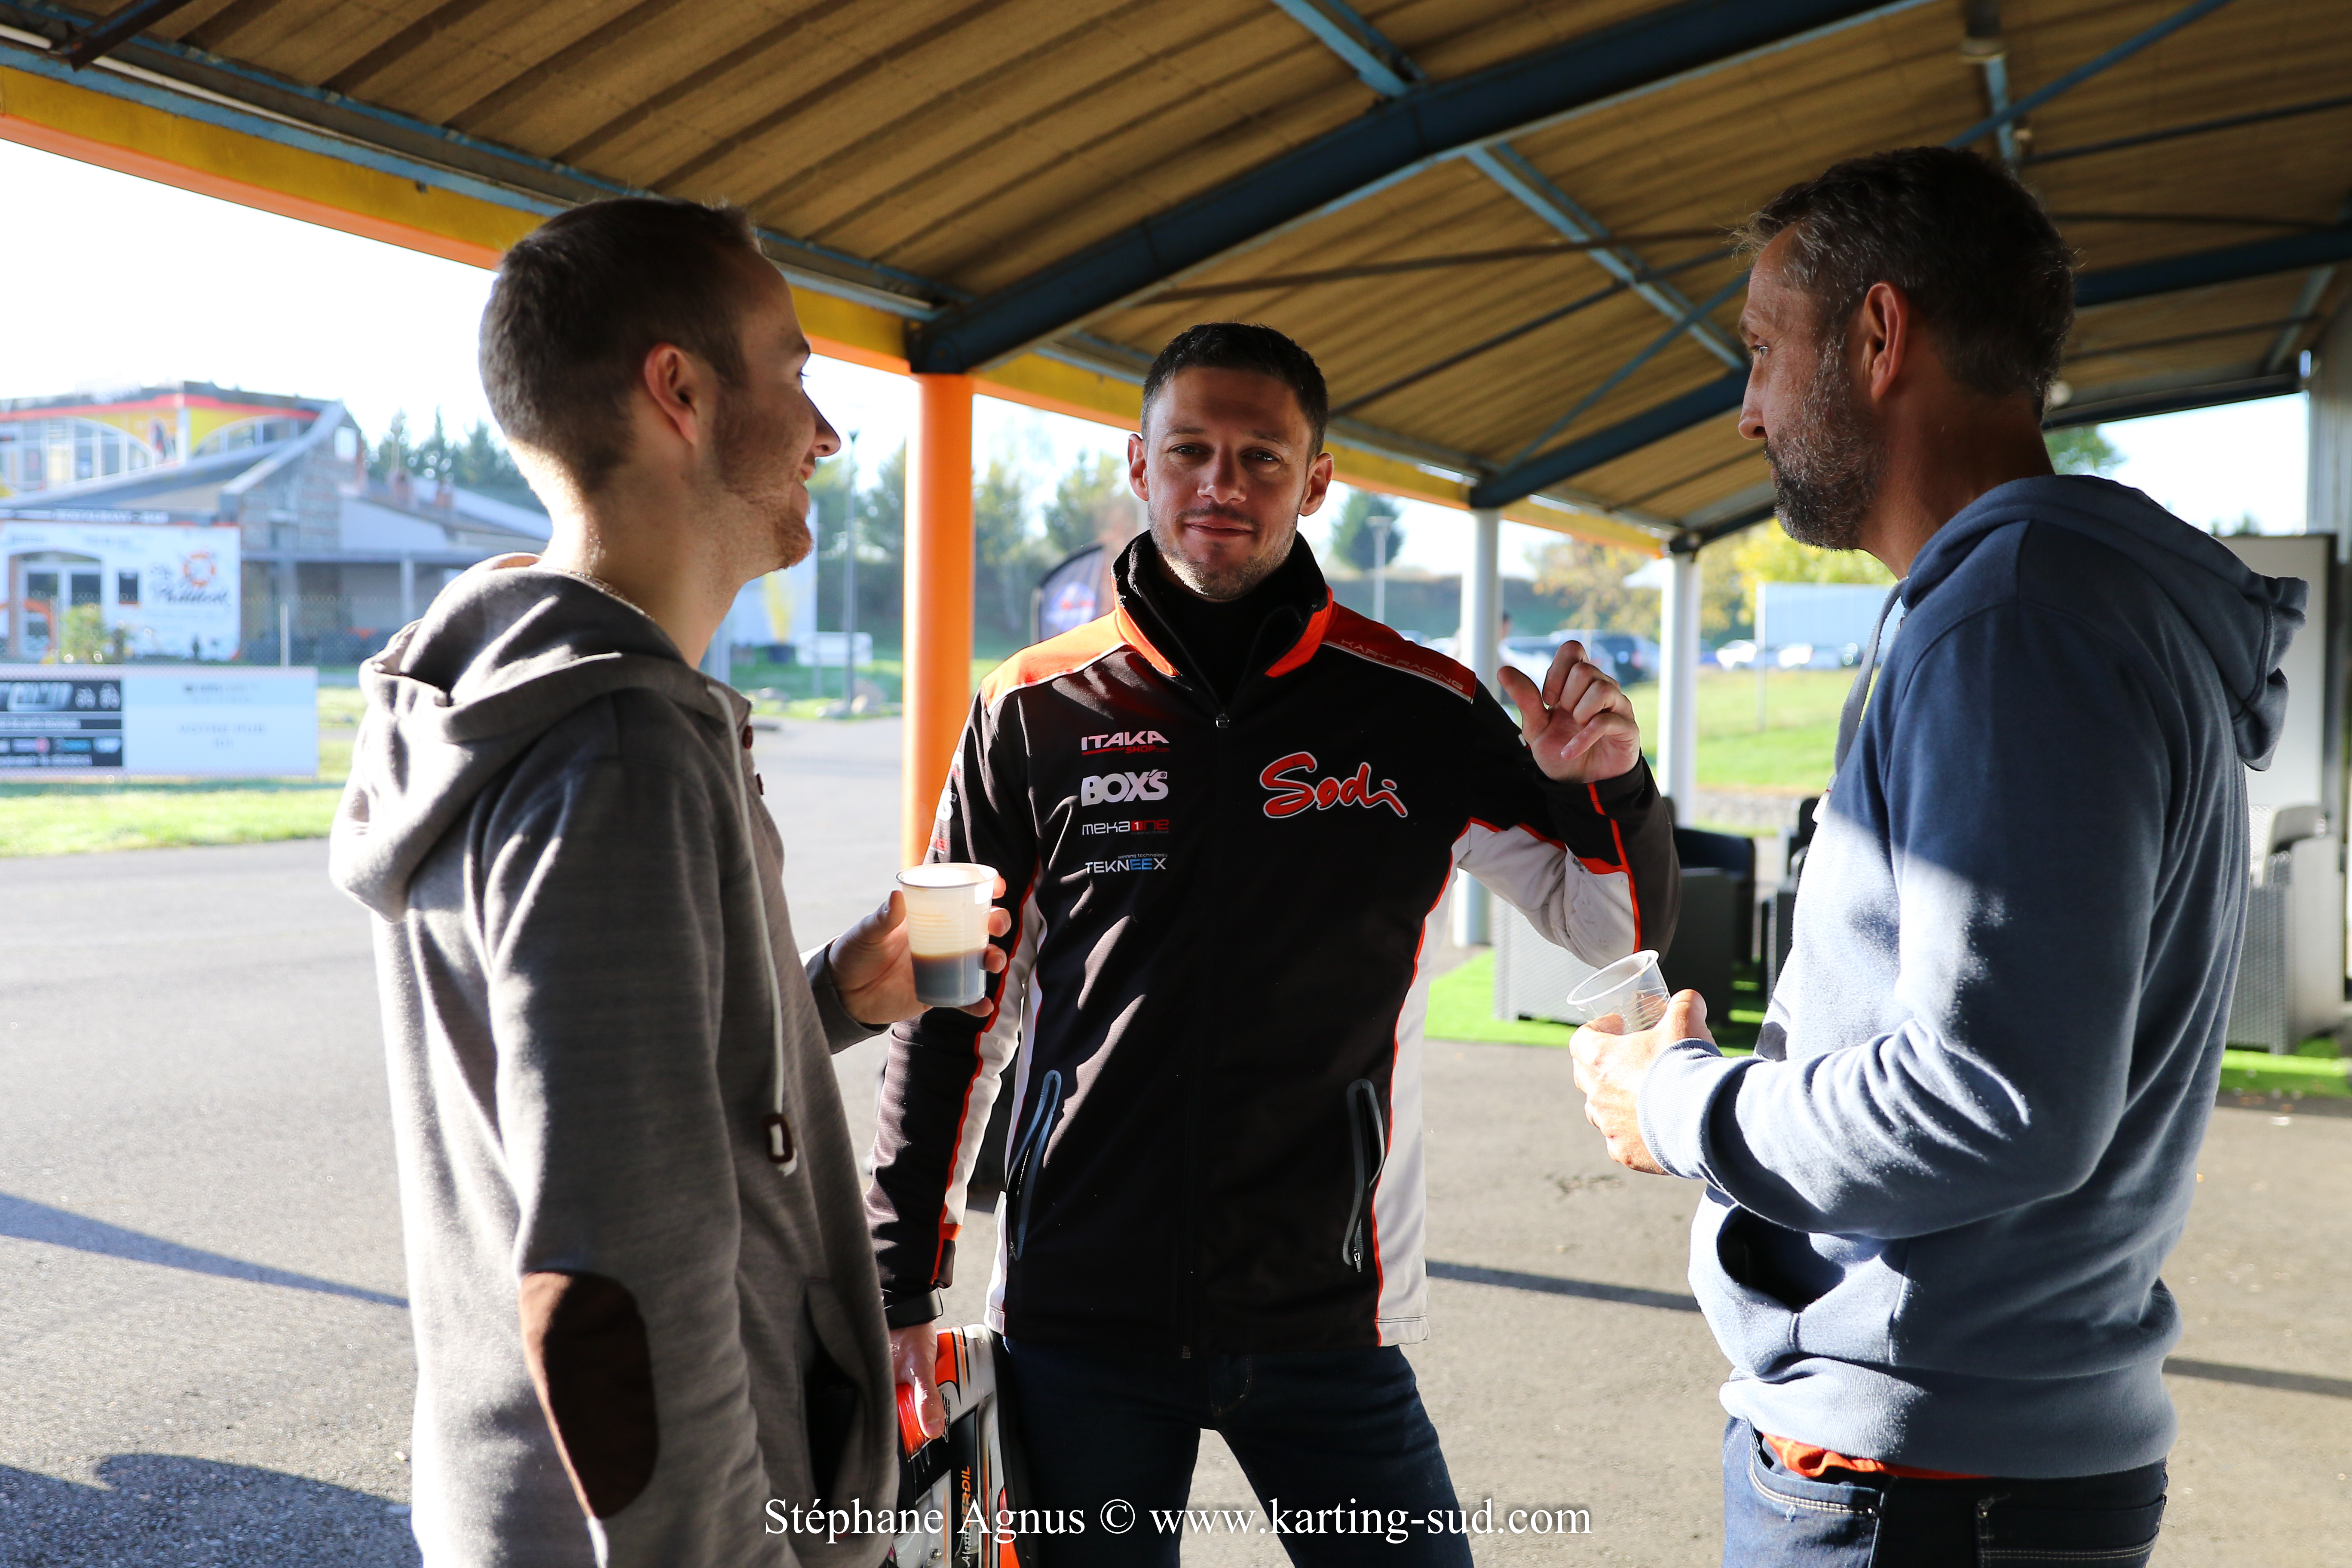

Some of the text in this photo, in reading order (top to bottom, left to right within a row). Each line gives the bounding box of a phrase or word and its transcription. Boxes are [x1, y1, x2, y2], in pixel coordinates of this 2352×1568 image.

[1341, 639, 1464, 690] KART RACING
[1081, 731, 1170, 751] ITAKA
[1259, 751, 1408, 818] Sodi
[1085, 858, 1167, 874] TEKNEEX
